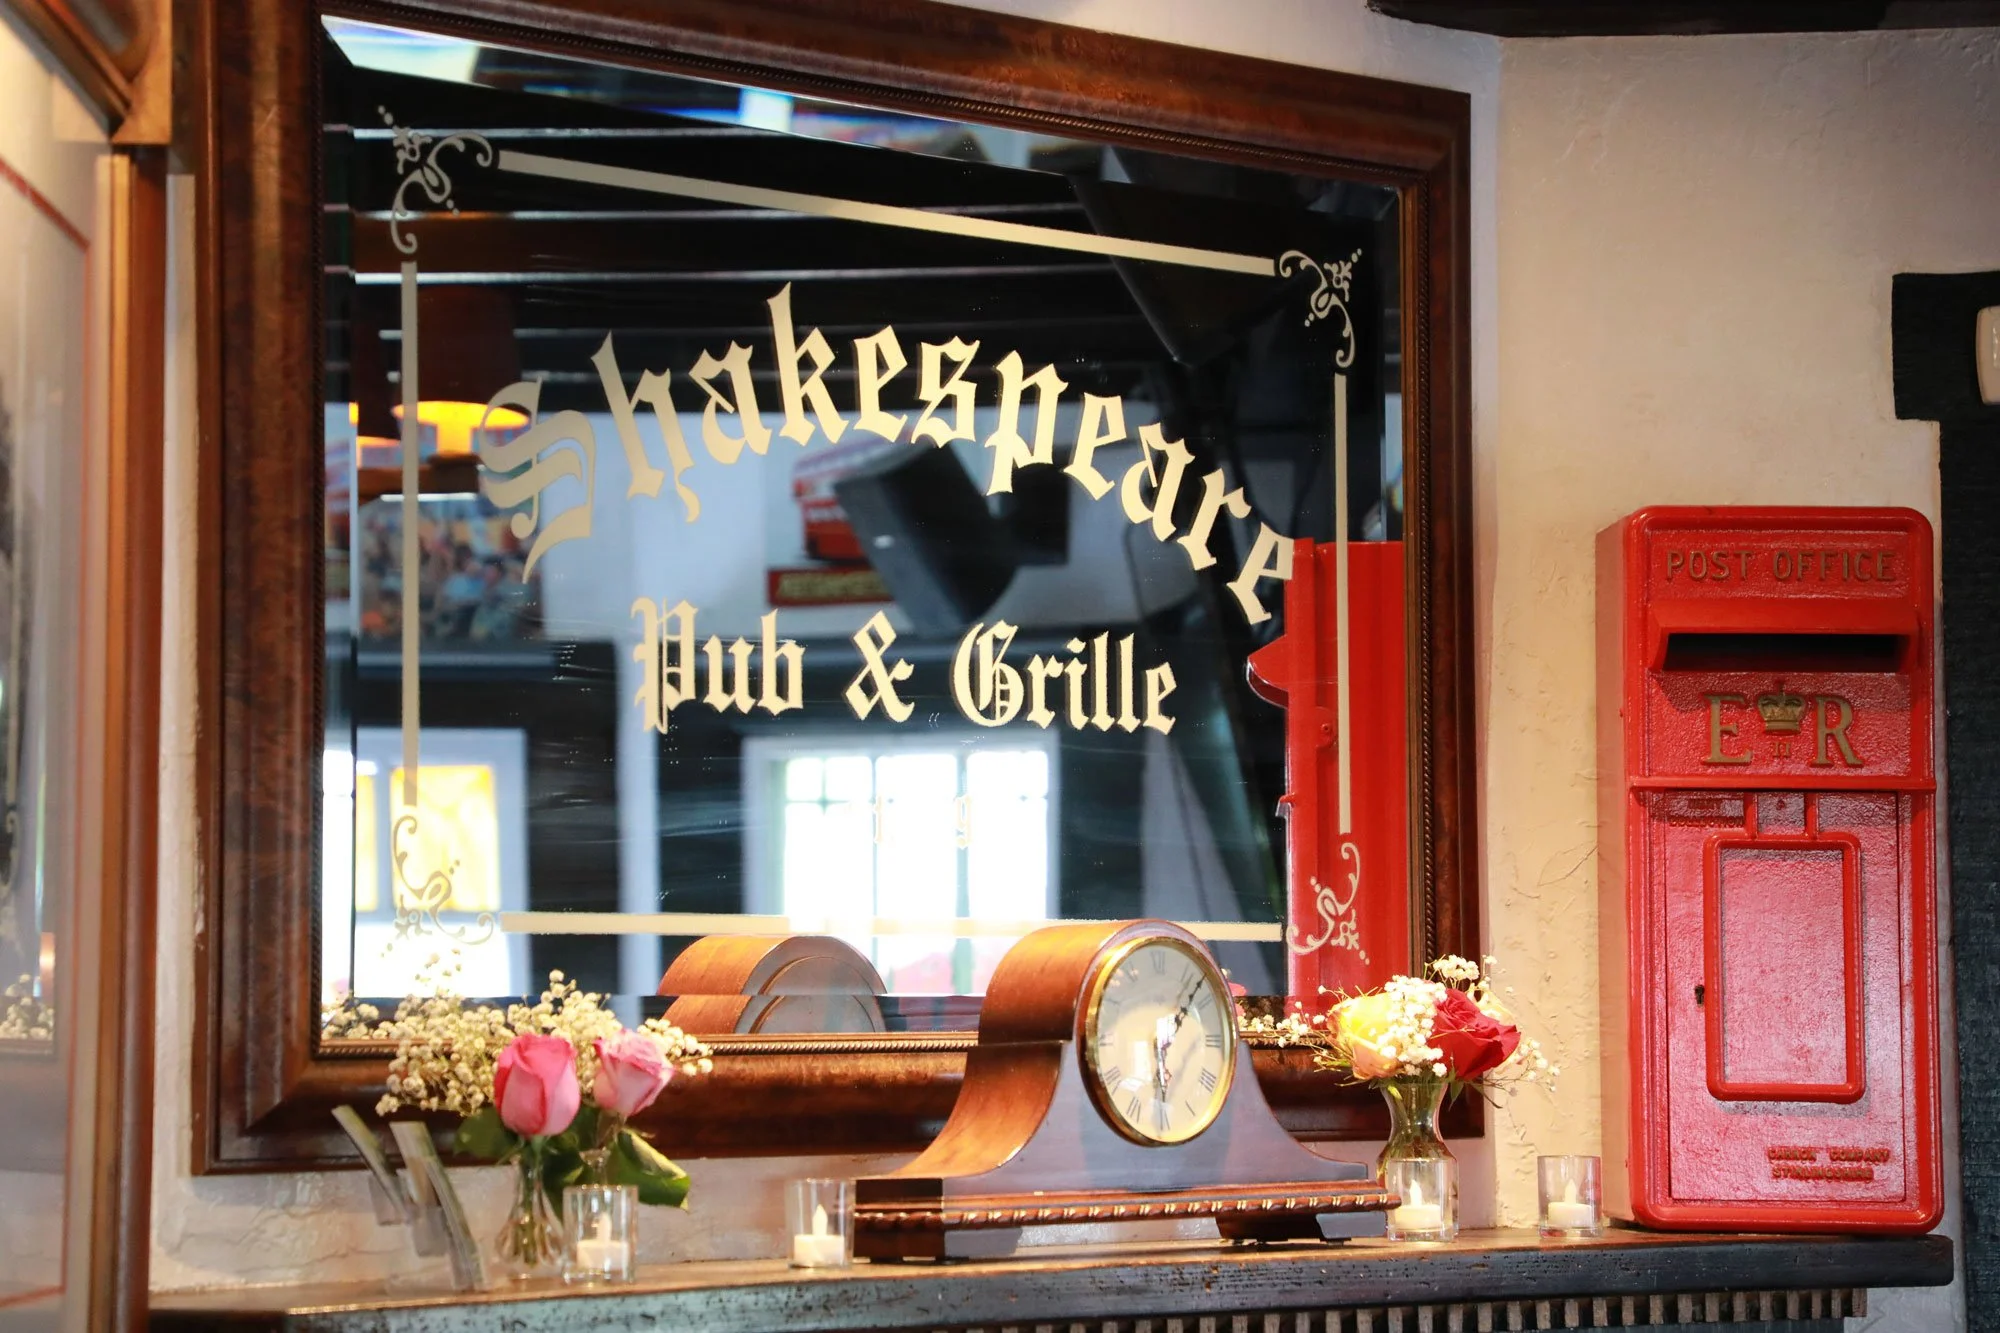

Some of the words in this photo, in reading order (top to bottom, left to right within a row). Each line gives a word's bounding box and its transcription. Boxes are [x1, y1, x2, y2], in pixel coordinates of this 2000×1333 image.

[478, 282, 1294, 625] Shakespeare
[1664, 550, 1751, 581] POST
[1771, 549, 1898, 582] OFFICE
[630, 597, 805, 735] Pub
[845, 610, 914, 723] &
[953, 619, 1177, 735] Grille
[1828, 1147, 1890, 1163] COMPANY
